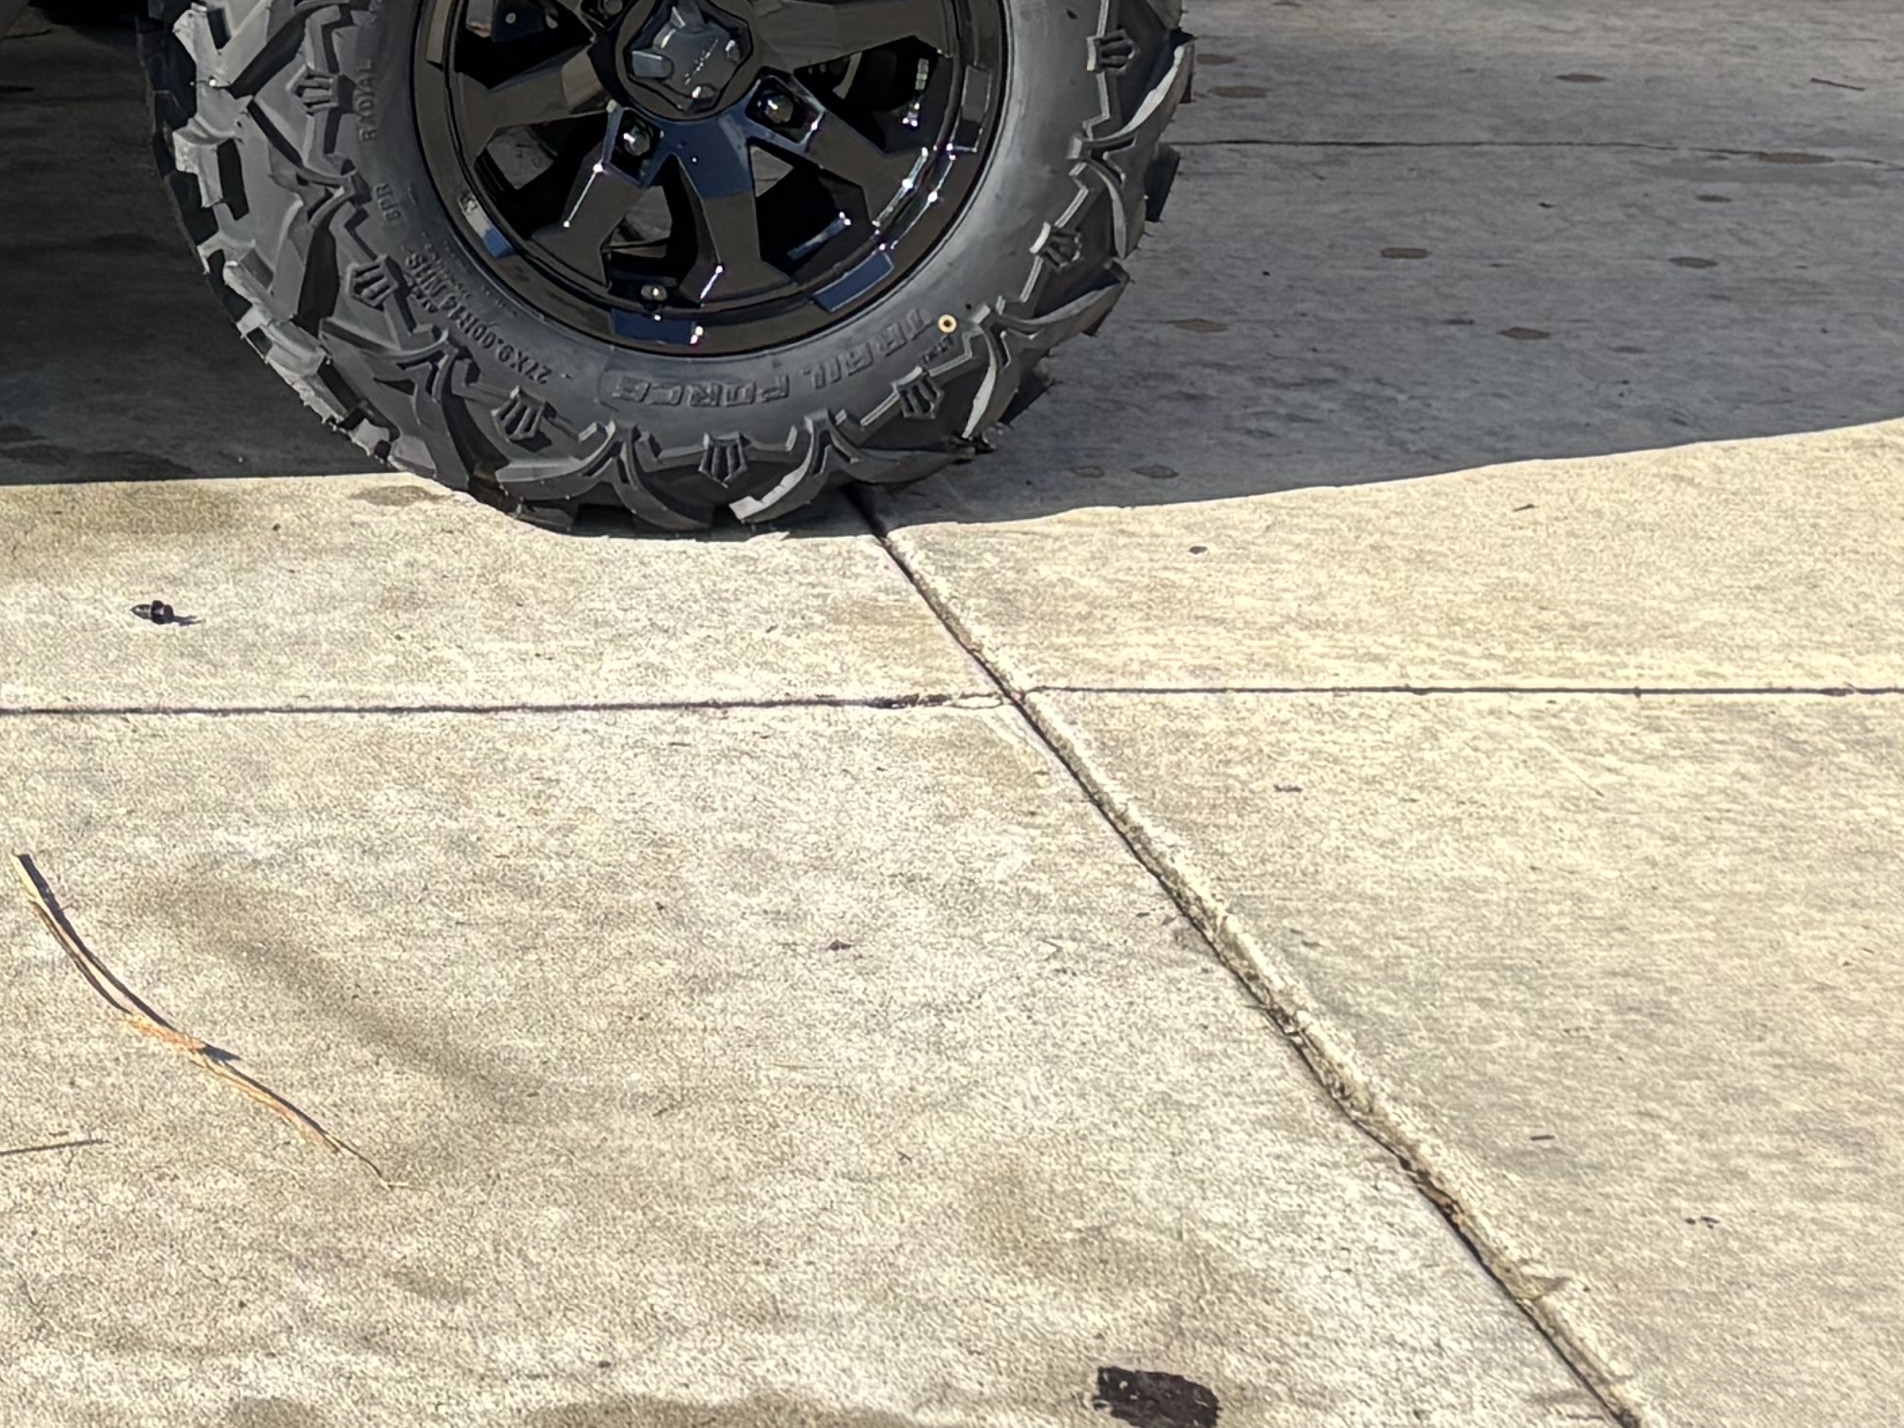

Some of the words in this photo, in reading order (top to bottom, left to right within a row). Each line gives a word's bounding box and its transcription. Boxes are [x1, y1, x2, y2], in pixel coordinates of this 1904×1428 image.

[352, 57, 378, 143] RADIAL
[611, 373, 790, 409] FORCE
[804, 308, 932, 392] TRAIL
